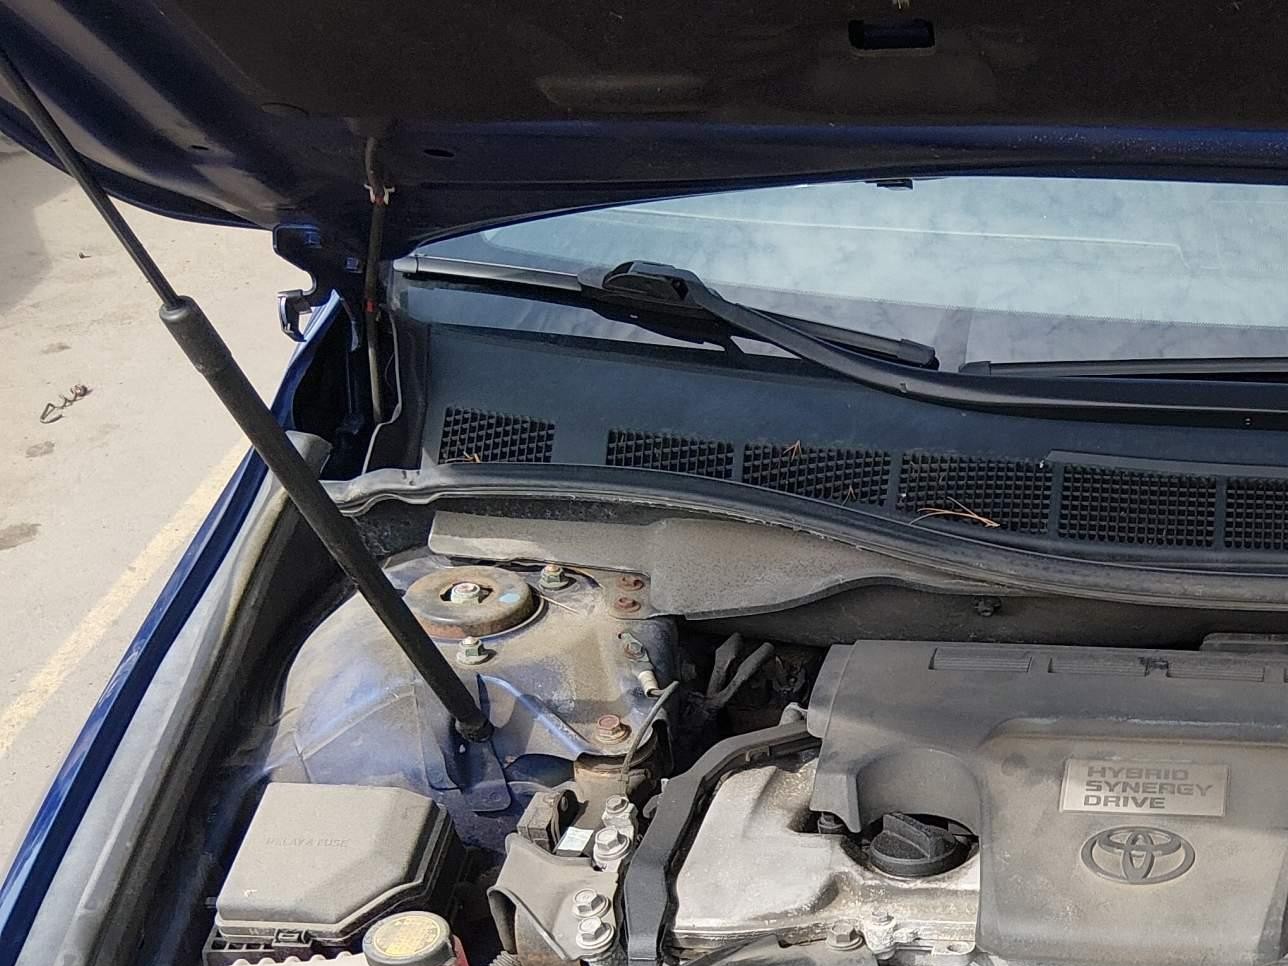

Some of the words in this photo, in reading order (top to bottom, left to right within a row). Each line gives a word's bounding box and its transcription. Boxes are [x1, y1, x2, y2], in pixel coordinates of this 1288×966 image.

[1087, 766, 1189, 781] HYBRID
[1085, 780, 1213, 796] SYNERGY
[1083, 794, 1166, 809] DRIVE
